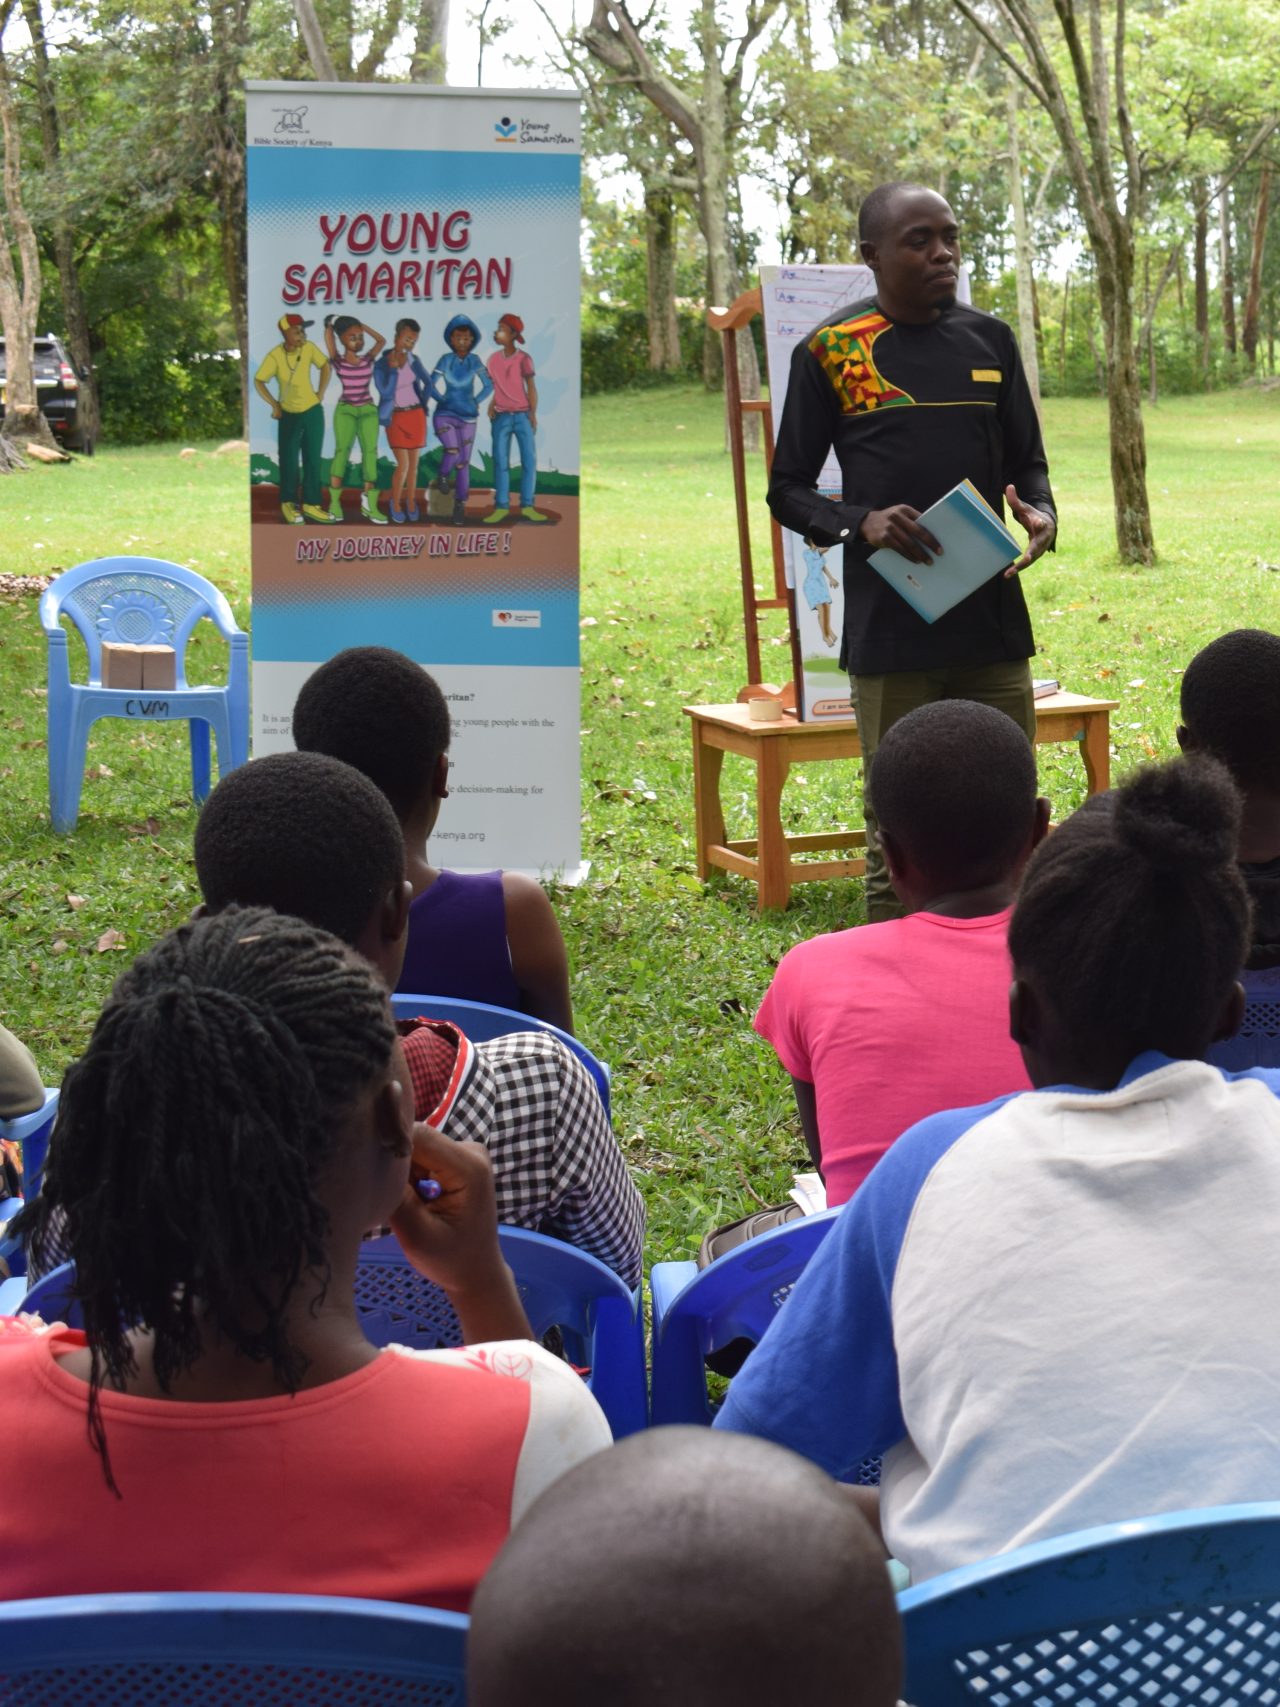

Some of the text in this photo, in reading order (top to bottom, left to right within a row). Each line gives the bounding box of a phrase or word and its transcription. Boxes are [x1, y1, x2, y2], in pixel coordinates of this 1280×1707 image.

[521, 119, 550, 133] Young
[273, 138, 298, 147] Society
[520, 131, 575, 144] Samaritan
[319, 210, 471, 254] YOUNG
[281, 256, 513, 304] SAMARITAN
[297, 539, 329, 560] MY
[333, 536, 425, 560] JOURNEY
[430, 534, 452, 555] IN
[456, 532, 499, 554] LIFE
[126, 699, 169, 716] CVM
[463, 719, 489, 728] young
[491, 719, 519, 728] people
[521, 719, 540, 727] with
[542, 719, 555, 727] the
[457, 784, 529, 795] decision-making
[531, 785, 544, 794] for
[432, 831, 486, 841] -kenya.org
